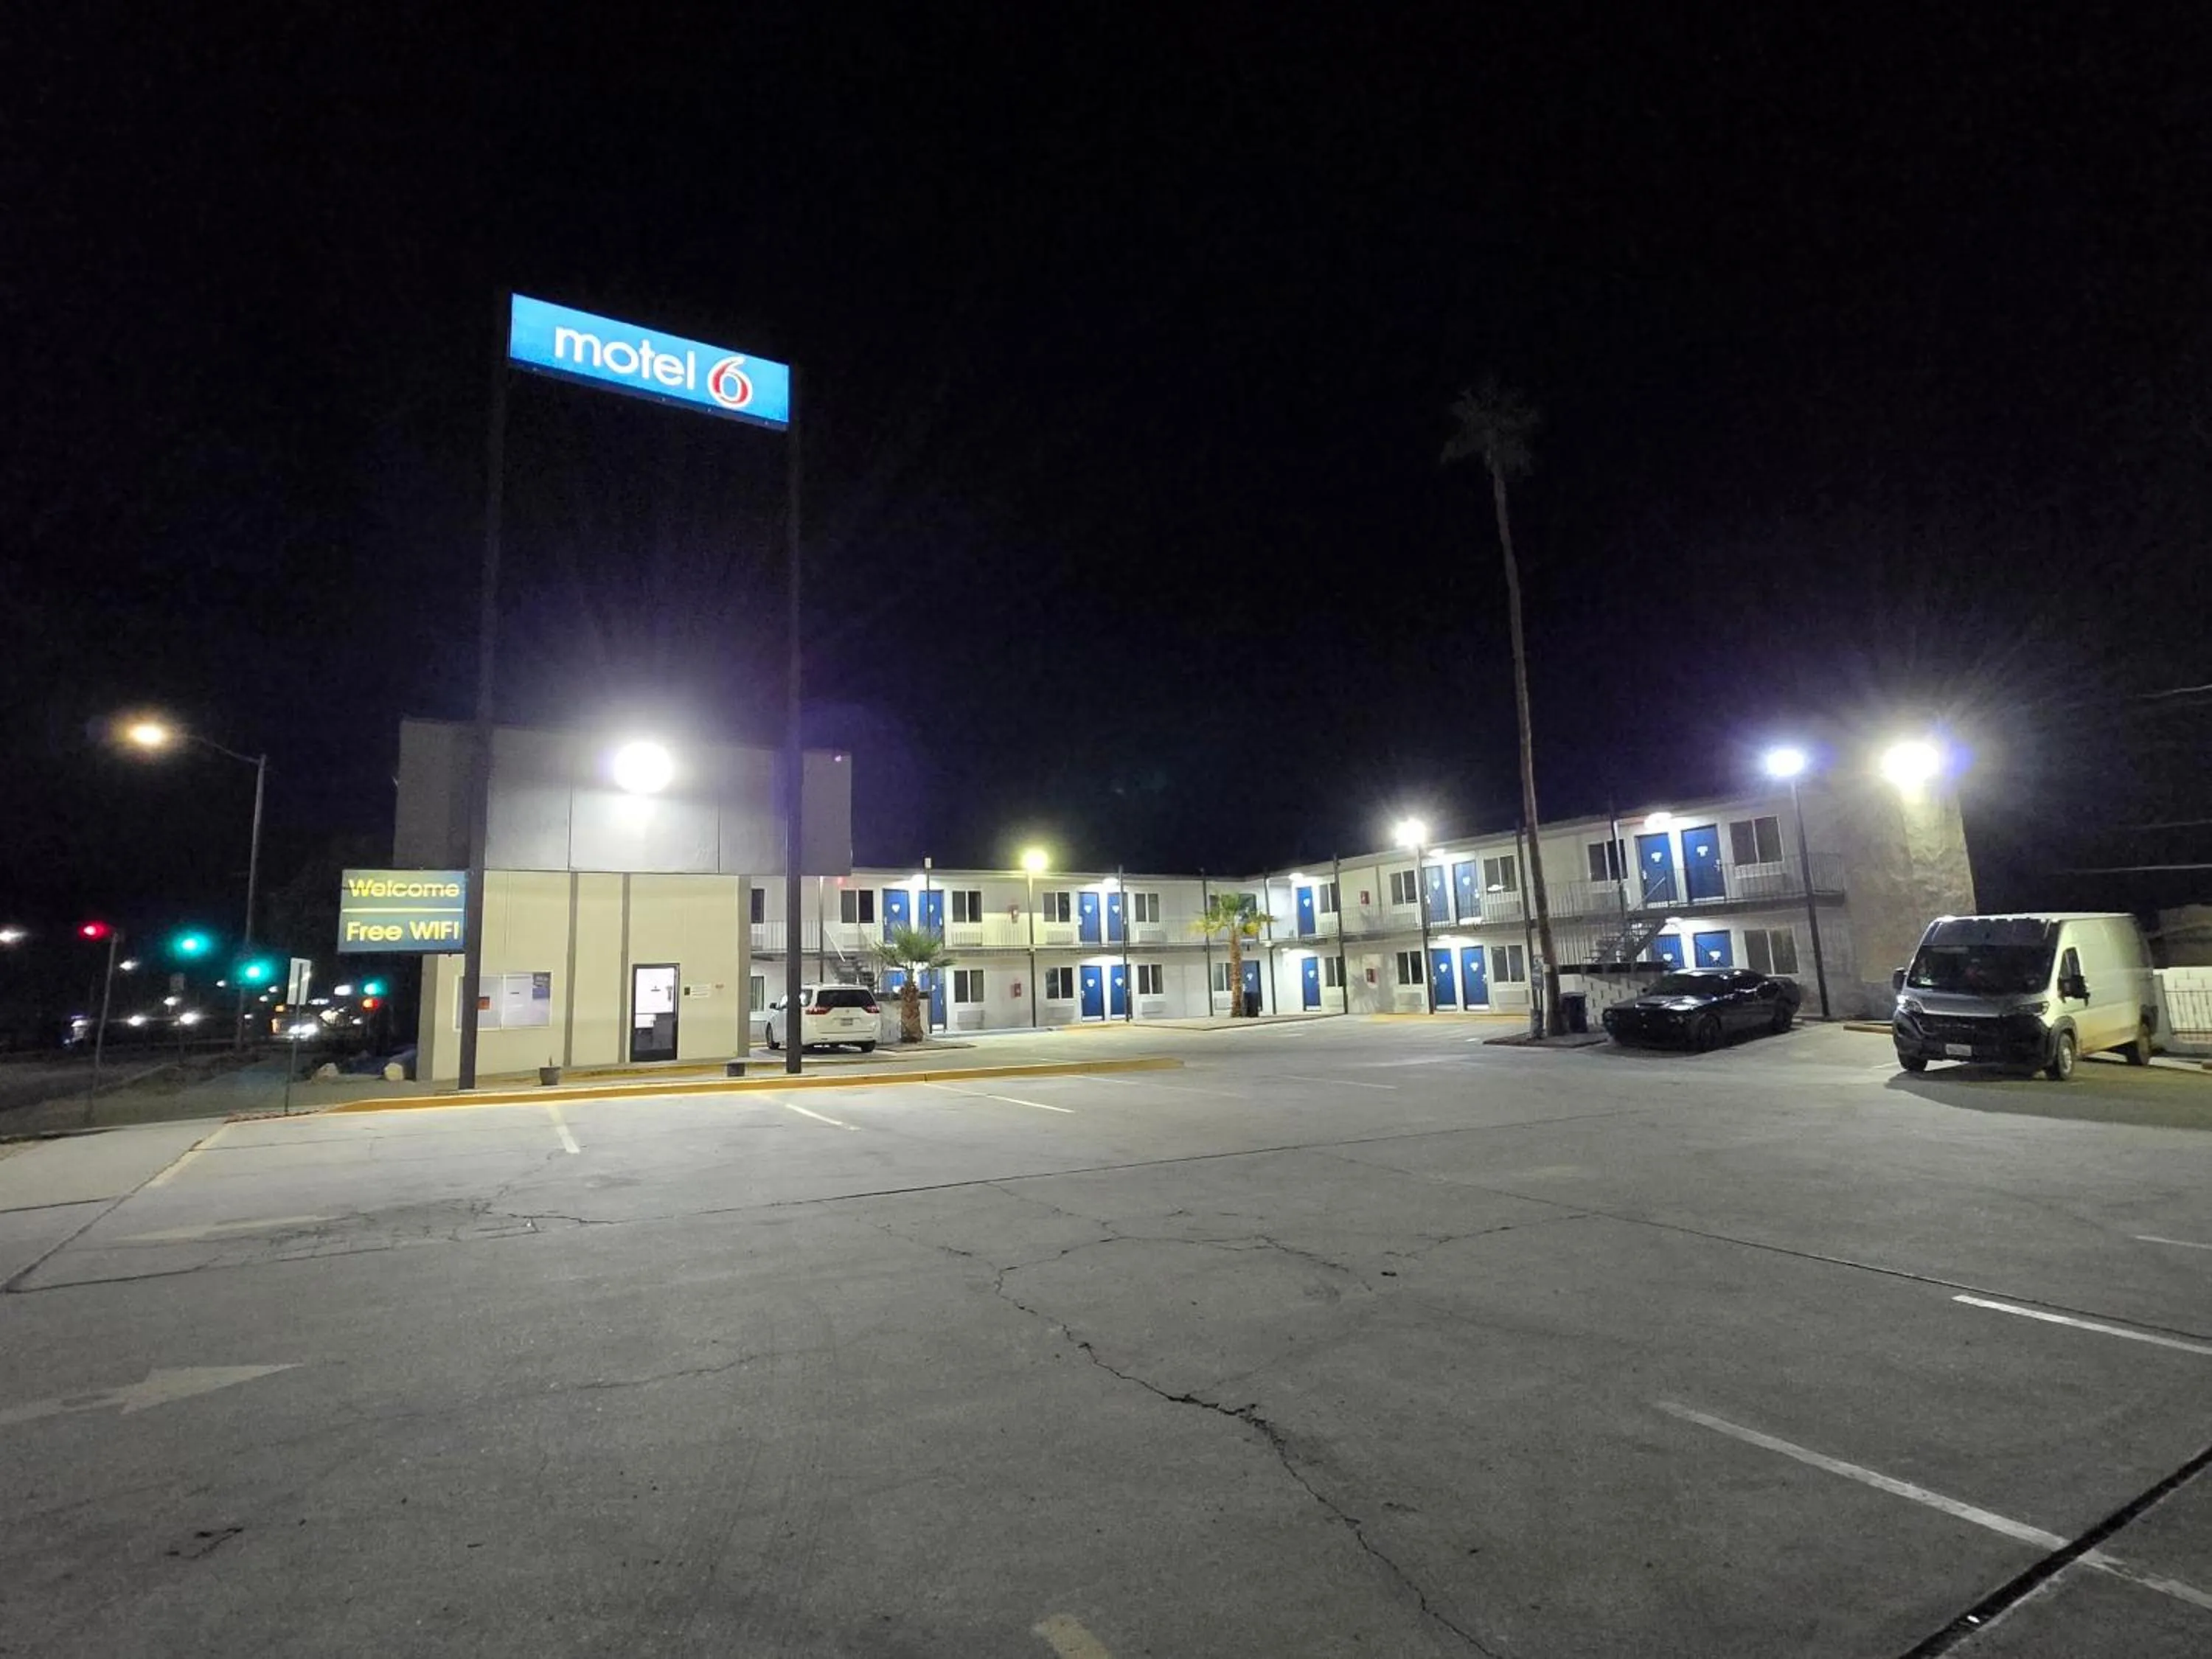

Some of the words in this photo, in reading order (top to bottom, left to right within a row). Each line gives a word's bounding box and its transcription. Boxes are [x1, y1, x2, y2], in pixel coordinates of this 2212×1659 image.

[554, 327, 695, 390] motel
[708, 356, 753, 408] 6
[348, 878, 460, 897] Welcome
[346, 921, 402, 942] Free
